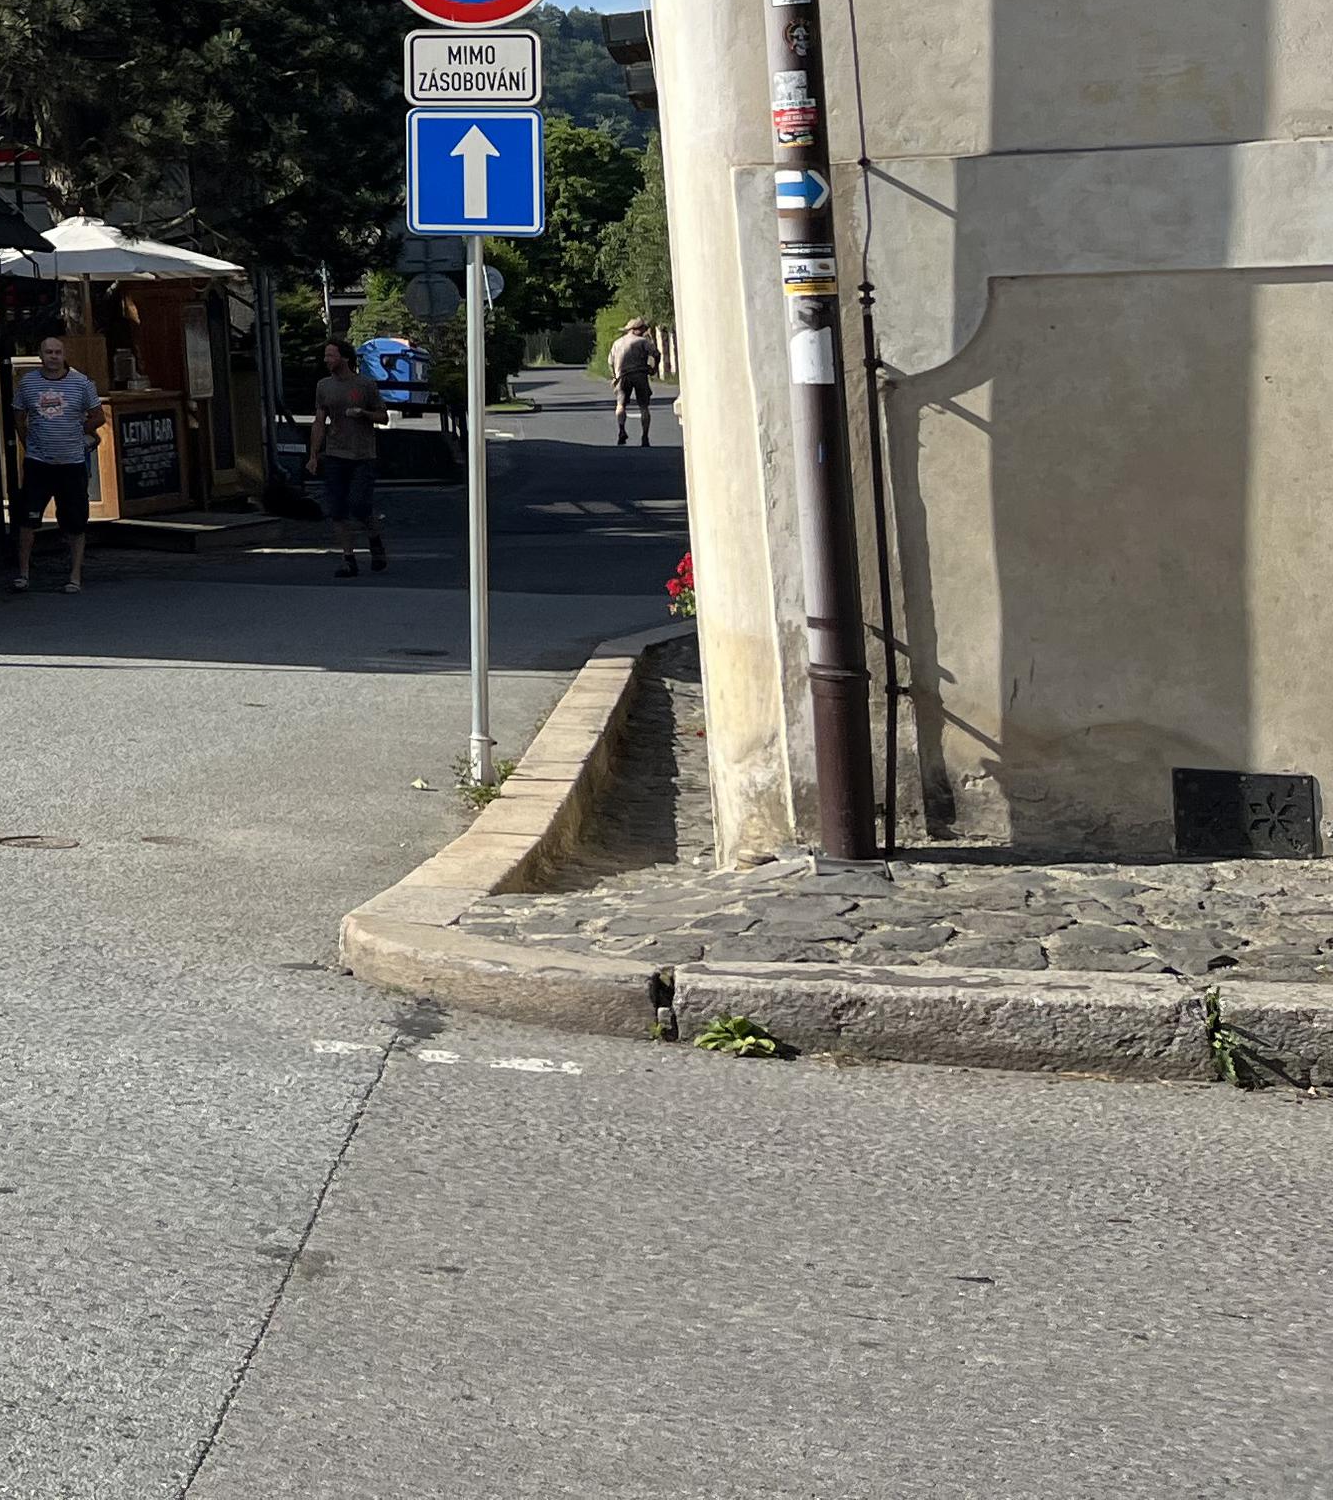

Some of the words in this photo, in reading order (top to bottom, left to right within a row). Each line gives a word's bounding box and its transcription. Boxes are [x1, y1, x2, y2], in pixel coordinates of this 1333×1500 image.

[447, 45, 496, 65] MIMO
[418, 67, 527, 92] ZÁSOBOVÁNÍ
[154, 417, 174, 442] BAR
